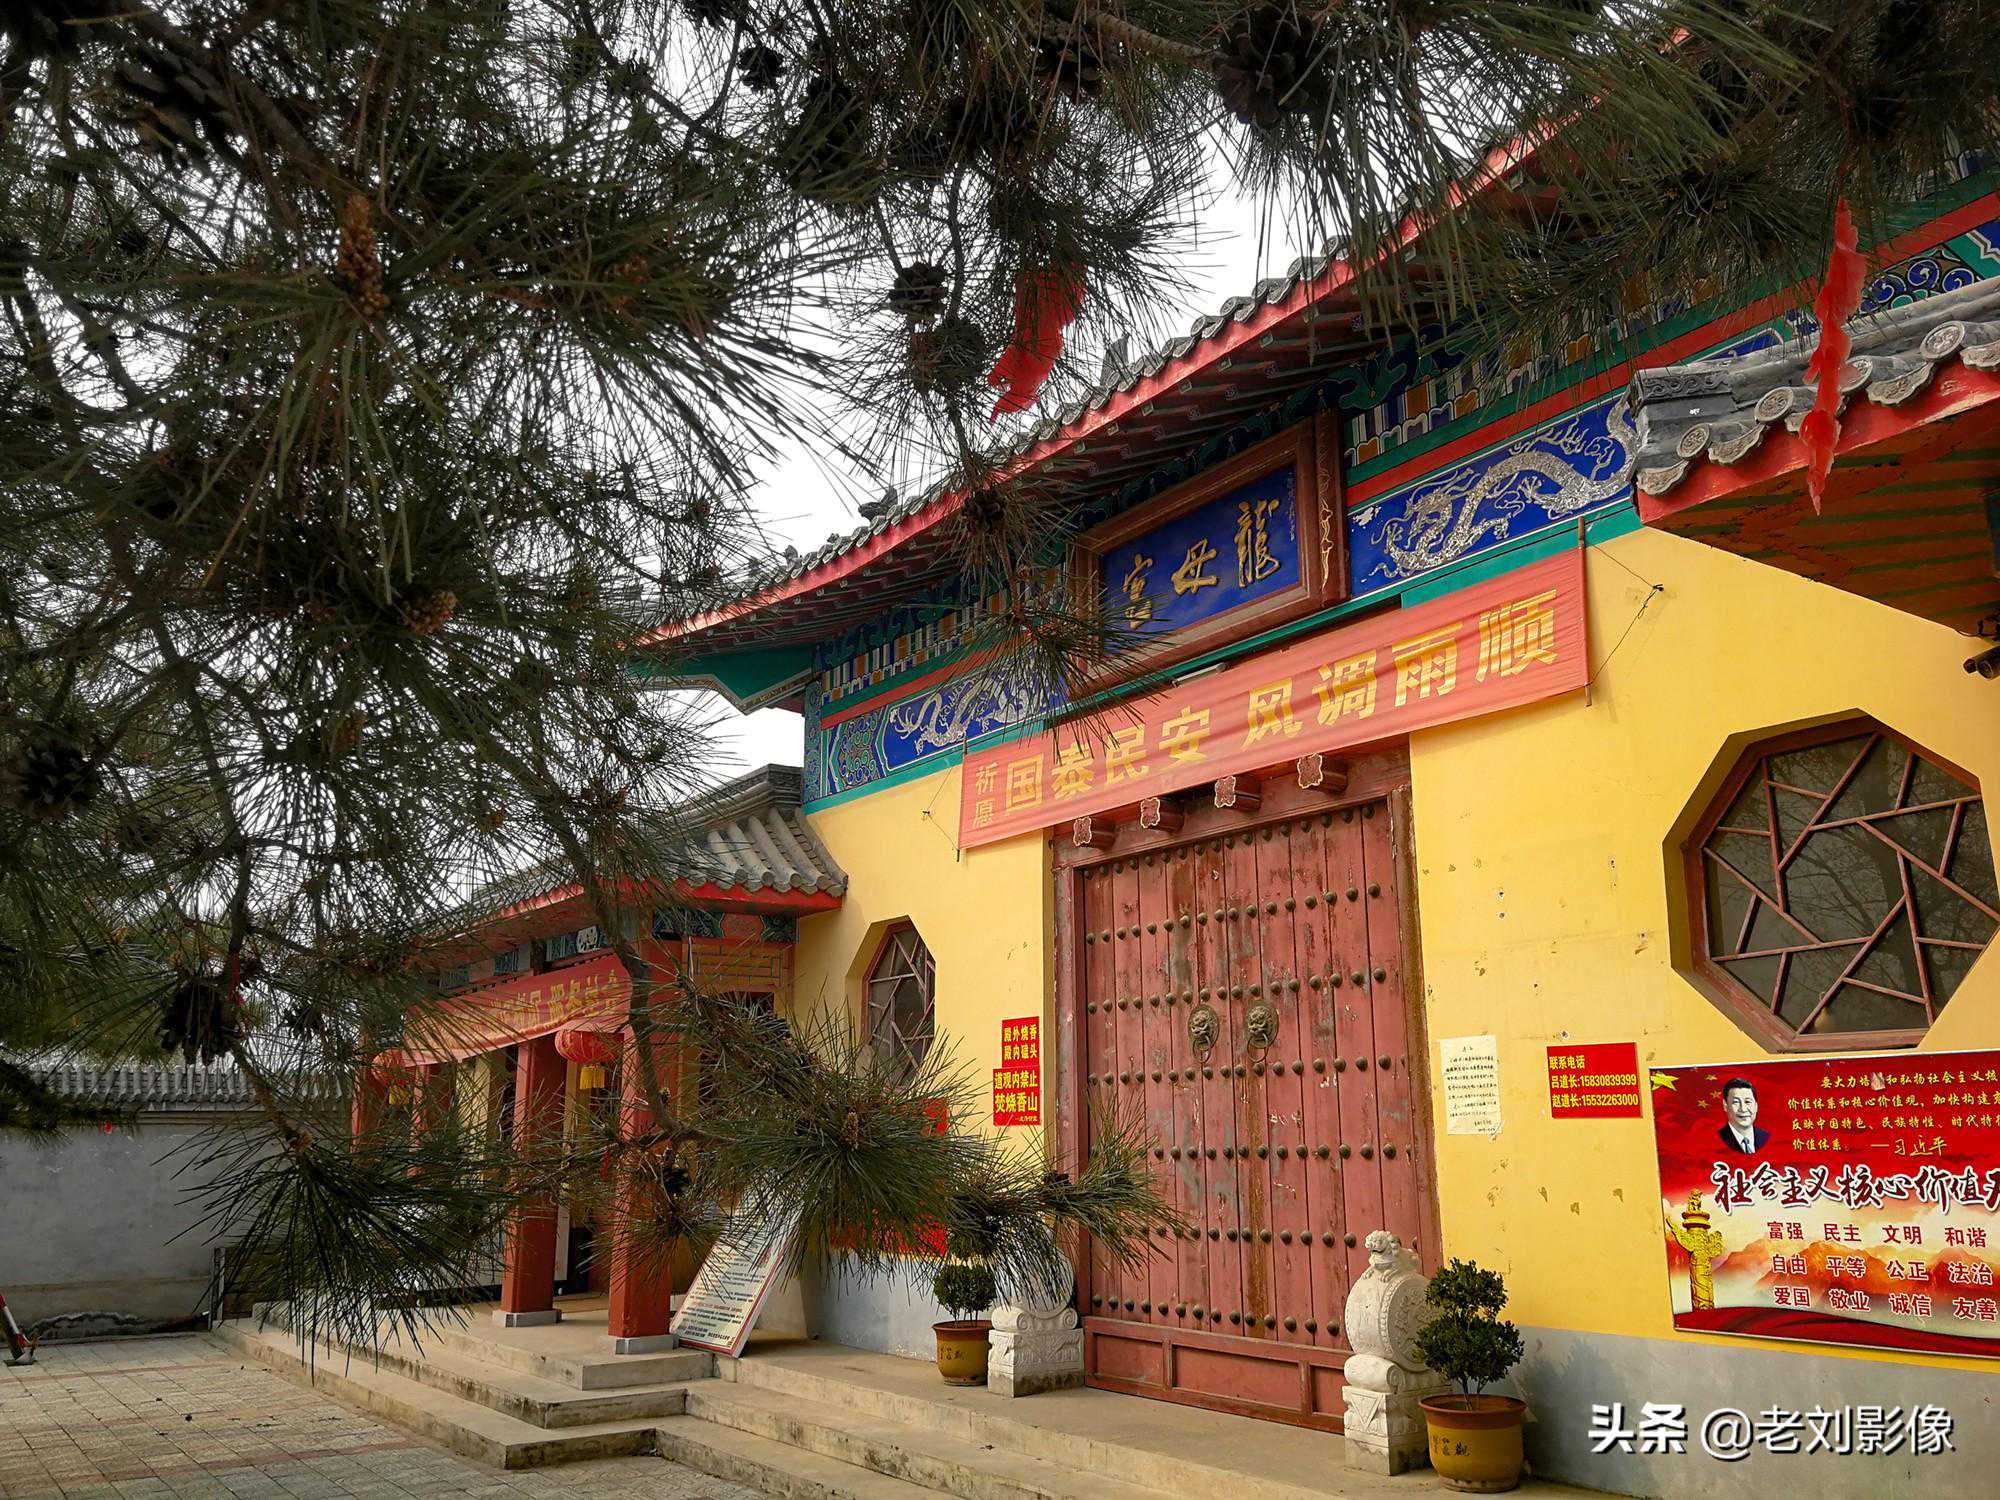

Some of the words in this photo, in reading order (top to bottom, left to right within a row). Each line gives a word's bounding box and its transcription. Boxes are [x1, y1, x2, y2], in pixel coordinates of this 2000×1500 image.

[1004, 704, 1211, 816] 国泰民安
[1241, 588, 1559, 752] 风调雨顺
[972, 761, 999, 828] 祈愿
[1004, 1024, 1037, 1042] 殿外烧香
[1549, 1055, 1585, 1069] 联系电话
[995, 1070, 1038, 1089] 道观内禁止
[1821, 1070, 1999, 1089] 要大力培和弘扬社会主义核
[1767, 1221, 1804, 1241] 富强
[1823, 1223, 1862, 1243] 民主
[1882, 1225, 1922, 1245] 文明
[1945, 1227, 1987, 1248] 和谐
[1771, 1255, 1807, 1275] 自由
[1827, 1256, 1866, 1278] 平等
[1885, 1260, 1929, 1280] 公正
[1948, 1262, 1993, 1285] 法治
[1774, 1287, 1811, 1307] 爱国
[1829, 1290, 1871, 1311] 敬业
[1889, 1293, 1932, 1316] 诚信
[1953, 1297, 1998, 1321] 友善
